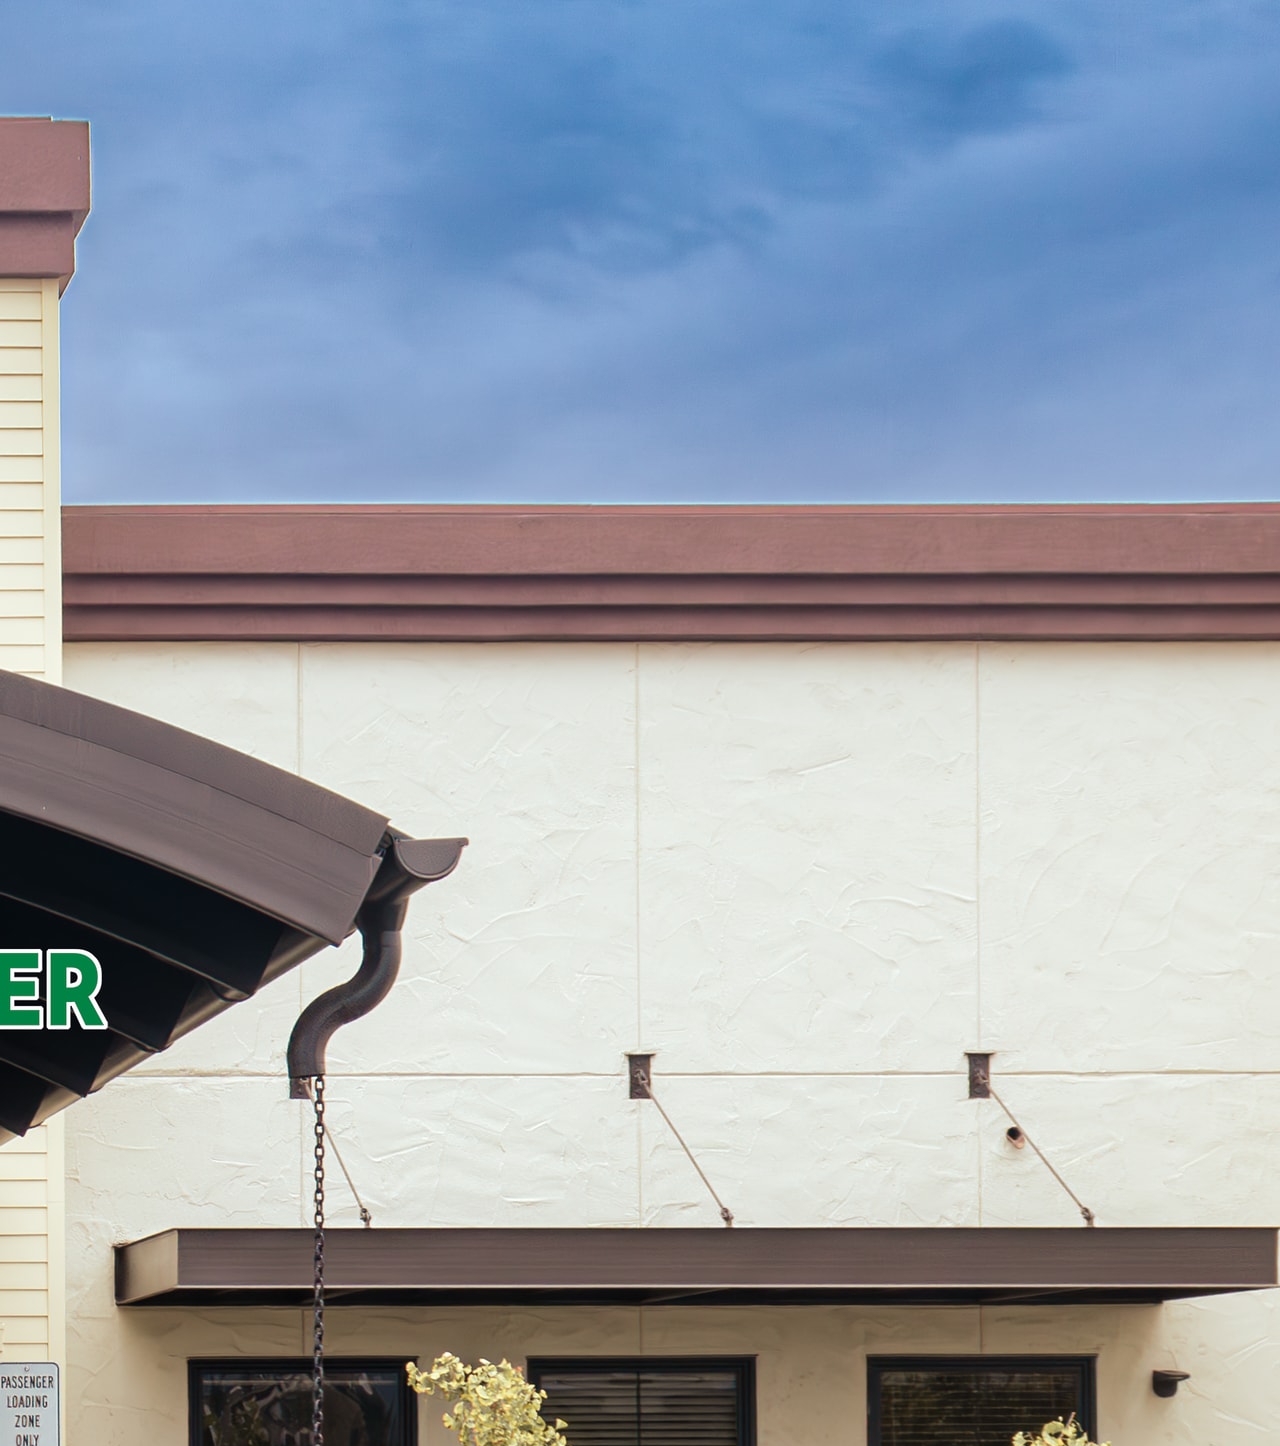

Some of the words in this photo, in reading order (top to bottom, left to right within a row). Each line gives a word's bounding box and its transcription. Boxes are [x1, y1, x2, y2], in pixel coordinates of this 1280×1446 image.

[1, 1375, 54, 1388] PASSENGER
[7, 1395, 48, 1408] LOADING
[15, 1415, 40, 1427] ZONE
[16, 1435, 39, 1446] ONLY
